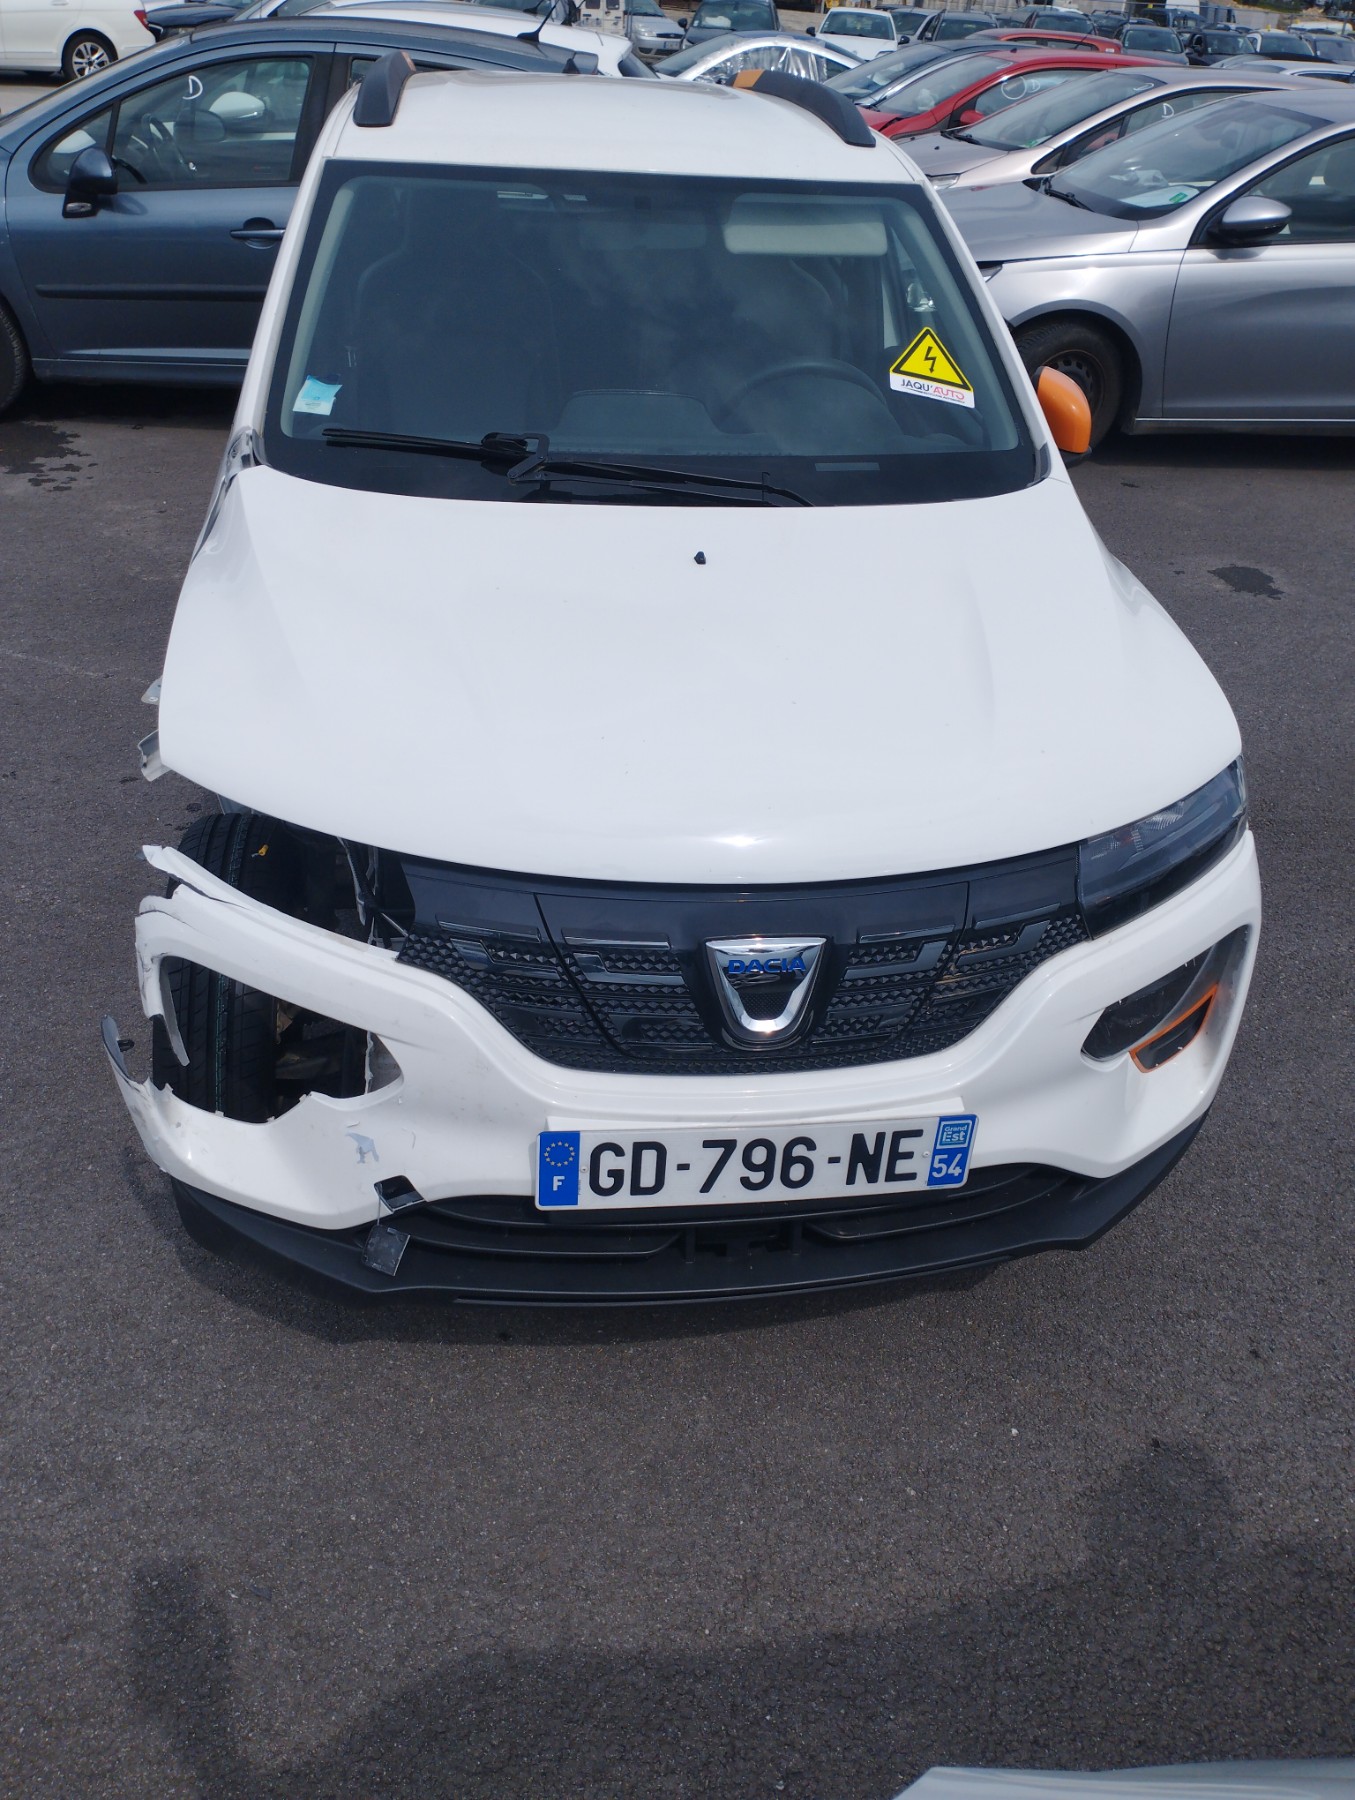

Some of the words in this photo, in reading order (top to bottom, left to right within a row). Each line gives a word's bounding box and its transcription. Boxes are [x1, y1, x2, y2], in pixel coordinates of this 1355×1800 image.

[727, 956, 807, 974] DACIA
[942, 1131, 966, 1142] Est
[944, 1124, 968, 1132] Grand
[588, 1128, 925, 1197] GD-796-NE
[931, 1153, 963, 1178] 54
[552, 1175, 566, 1192] F
